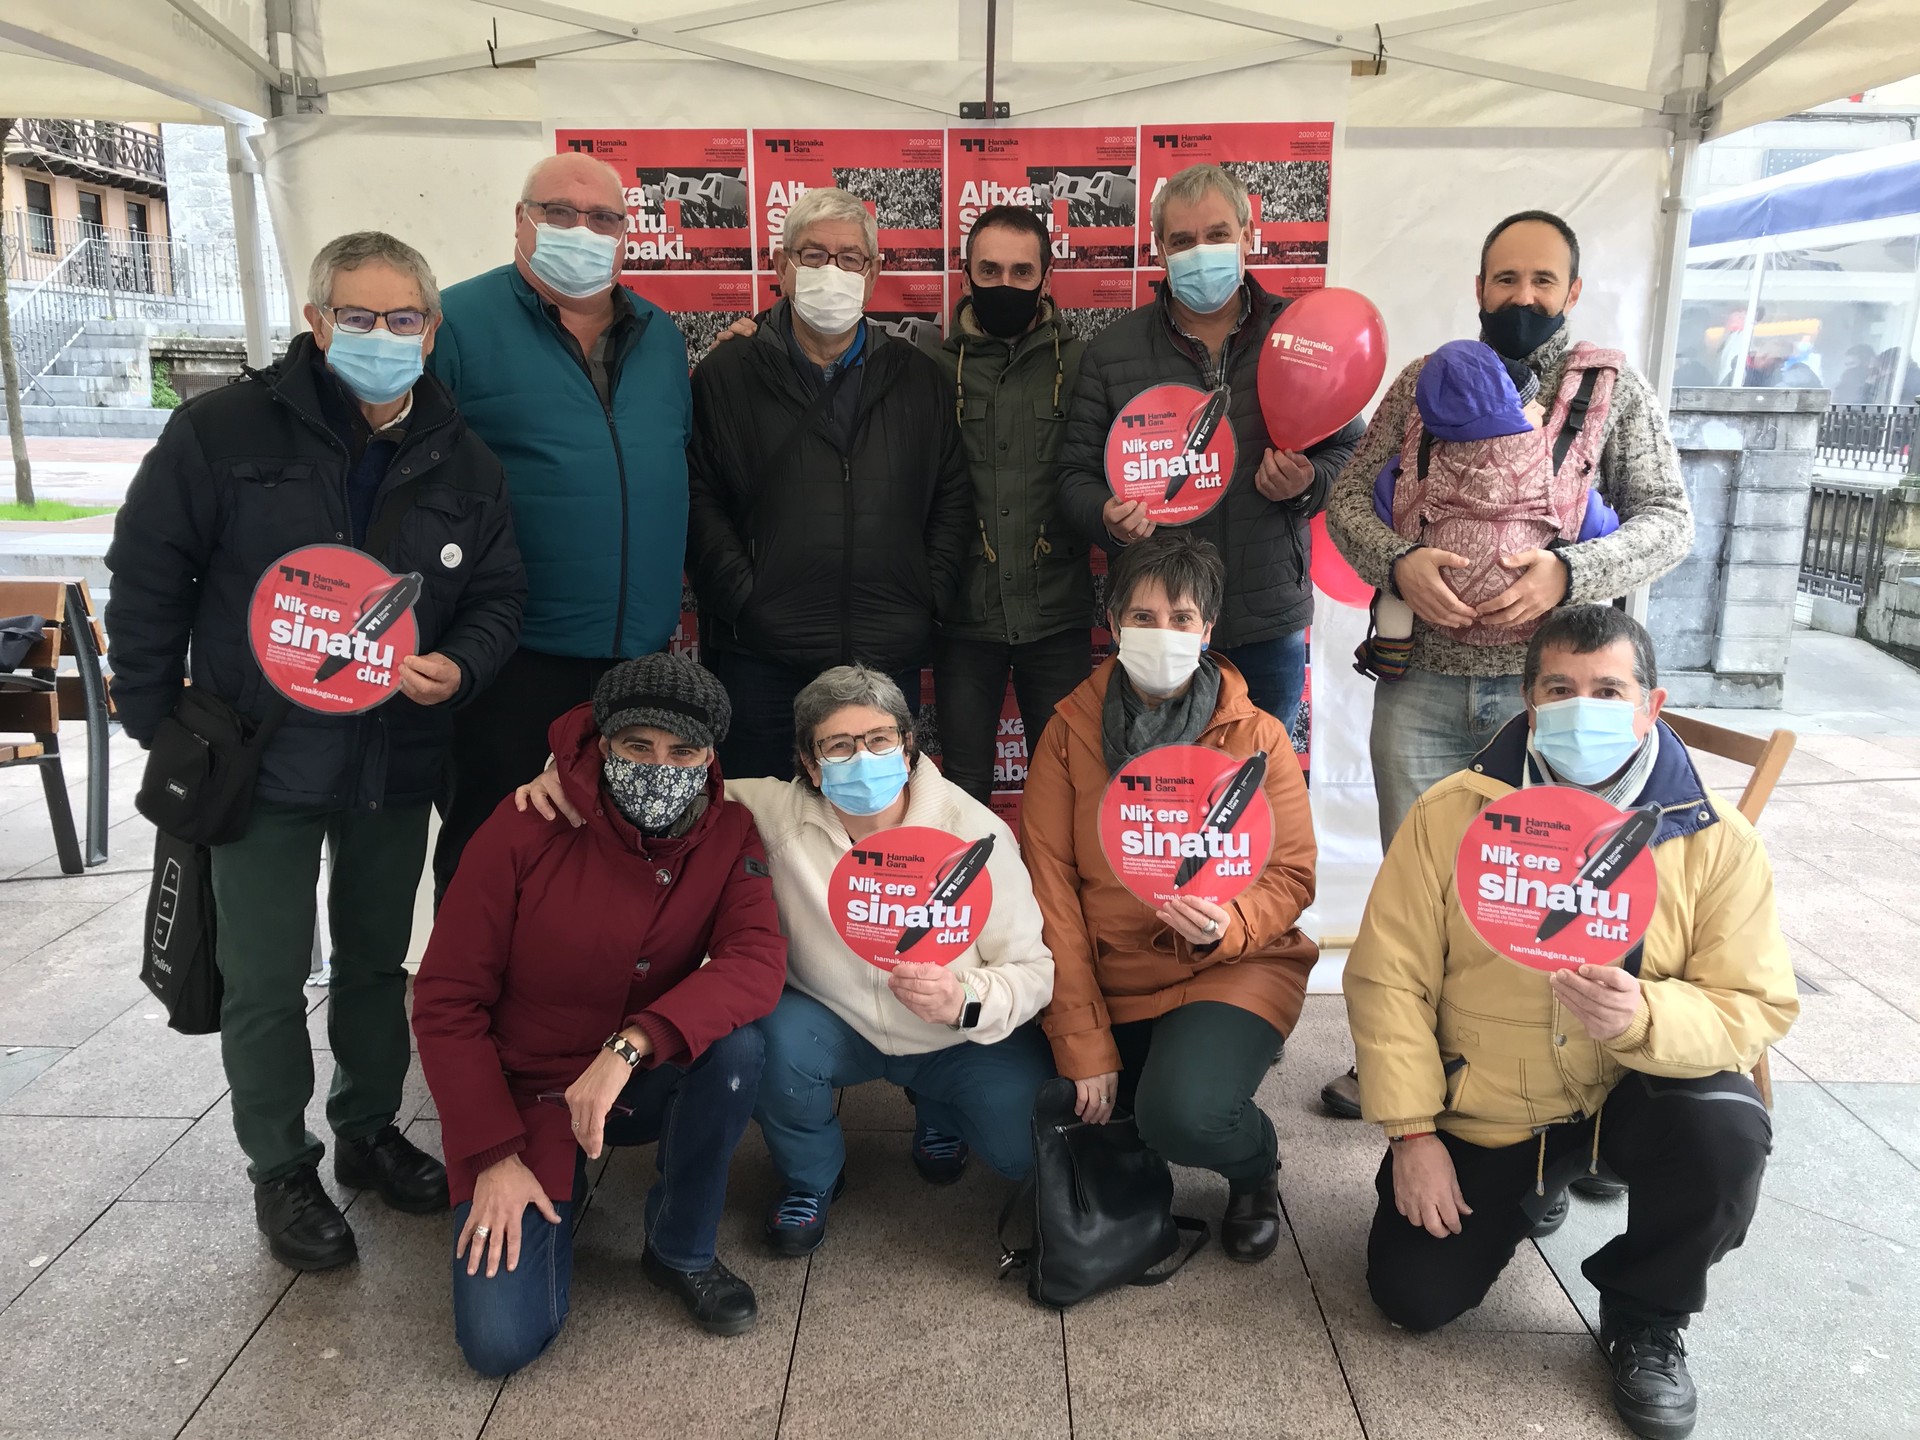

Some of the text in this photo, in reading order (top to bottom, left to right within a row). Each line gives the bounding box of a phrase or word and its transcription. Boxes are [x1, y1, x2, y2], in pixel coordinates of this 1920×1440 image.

[712, 137, 745, 145] 2020-2021
[959, 180, 1042, 206] Altxa.
[1294, 344, 1313, 355] Gara
[1296, 336, 1334, 352] Hamaika
[1148, 412, 1176, 420] Hamaika
[1122, 439, 1173, 454] Nik ere
[1123, 449, 1219, 482] sinatu
[1195, 474, 1222, 489] dut
[1149, 505, 1198, 515] hamaikagara.eus
[312, 582, 332, 592] Gara
[314, 573, 350, 589] Hamaika
[274, 593, 308, 616] Nik
[310, 605, 340, 622] ere
[269, 615, 395, 668] sinatu
[356, 666, 392, 686] dut
[291, 683, 353, 704] hamaikagara.eus
[1155, 776, 1194, 785] Hamaika
[1155, 784, 1176, 792] Gara
[1120, 804, 1189, 823] Nik ere
[1525, 826, 1550, 837] Gara
[1526, 817, 1571, 832] Hamaika
[1121, 823, 1250, 858] sinatu
[887, 853, 925, 862] Hamaika
[1481, 844, 1520, 867] Nik
[1523, 854, 1560, 872] ere
[1215, 859, 1251, 876] dut
[848, 876, 916, 896] Nik ere
[1478, 867, 1630, 921] sinatu
[846, 894, 972, 928] sinatu
[936, 929, 970, 944] dut
[1586, 919, 1629, 942] dut
[1510, 944, 1585, 964] hamaikagara.eus
